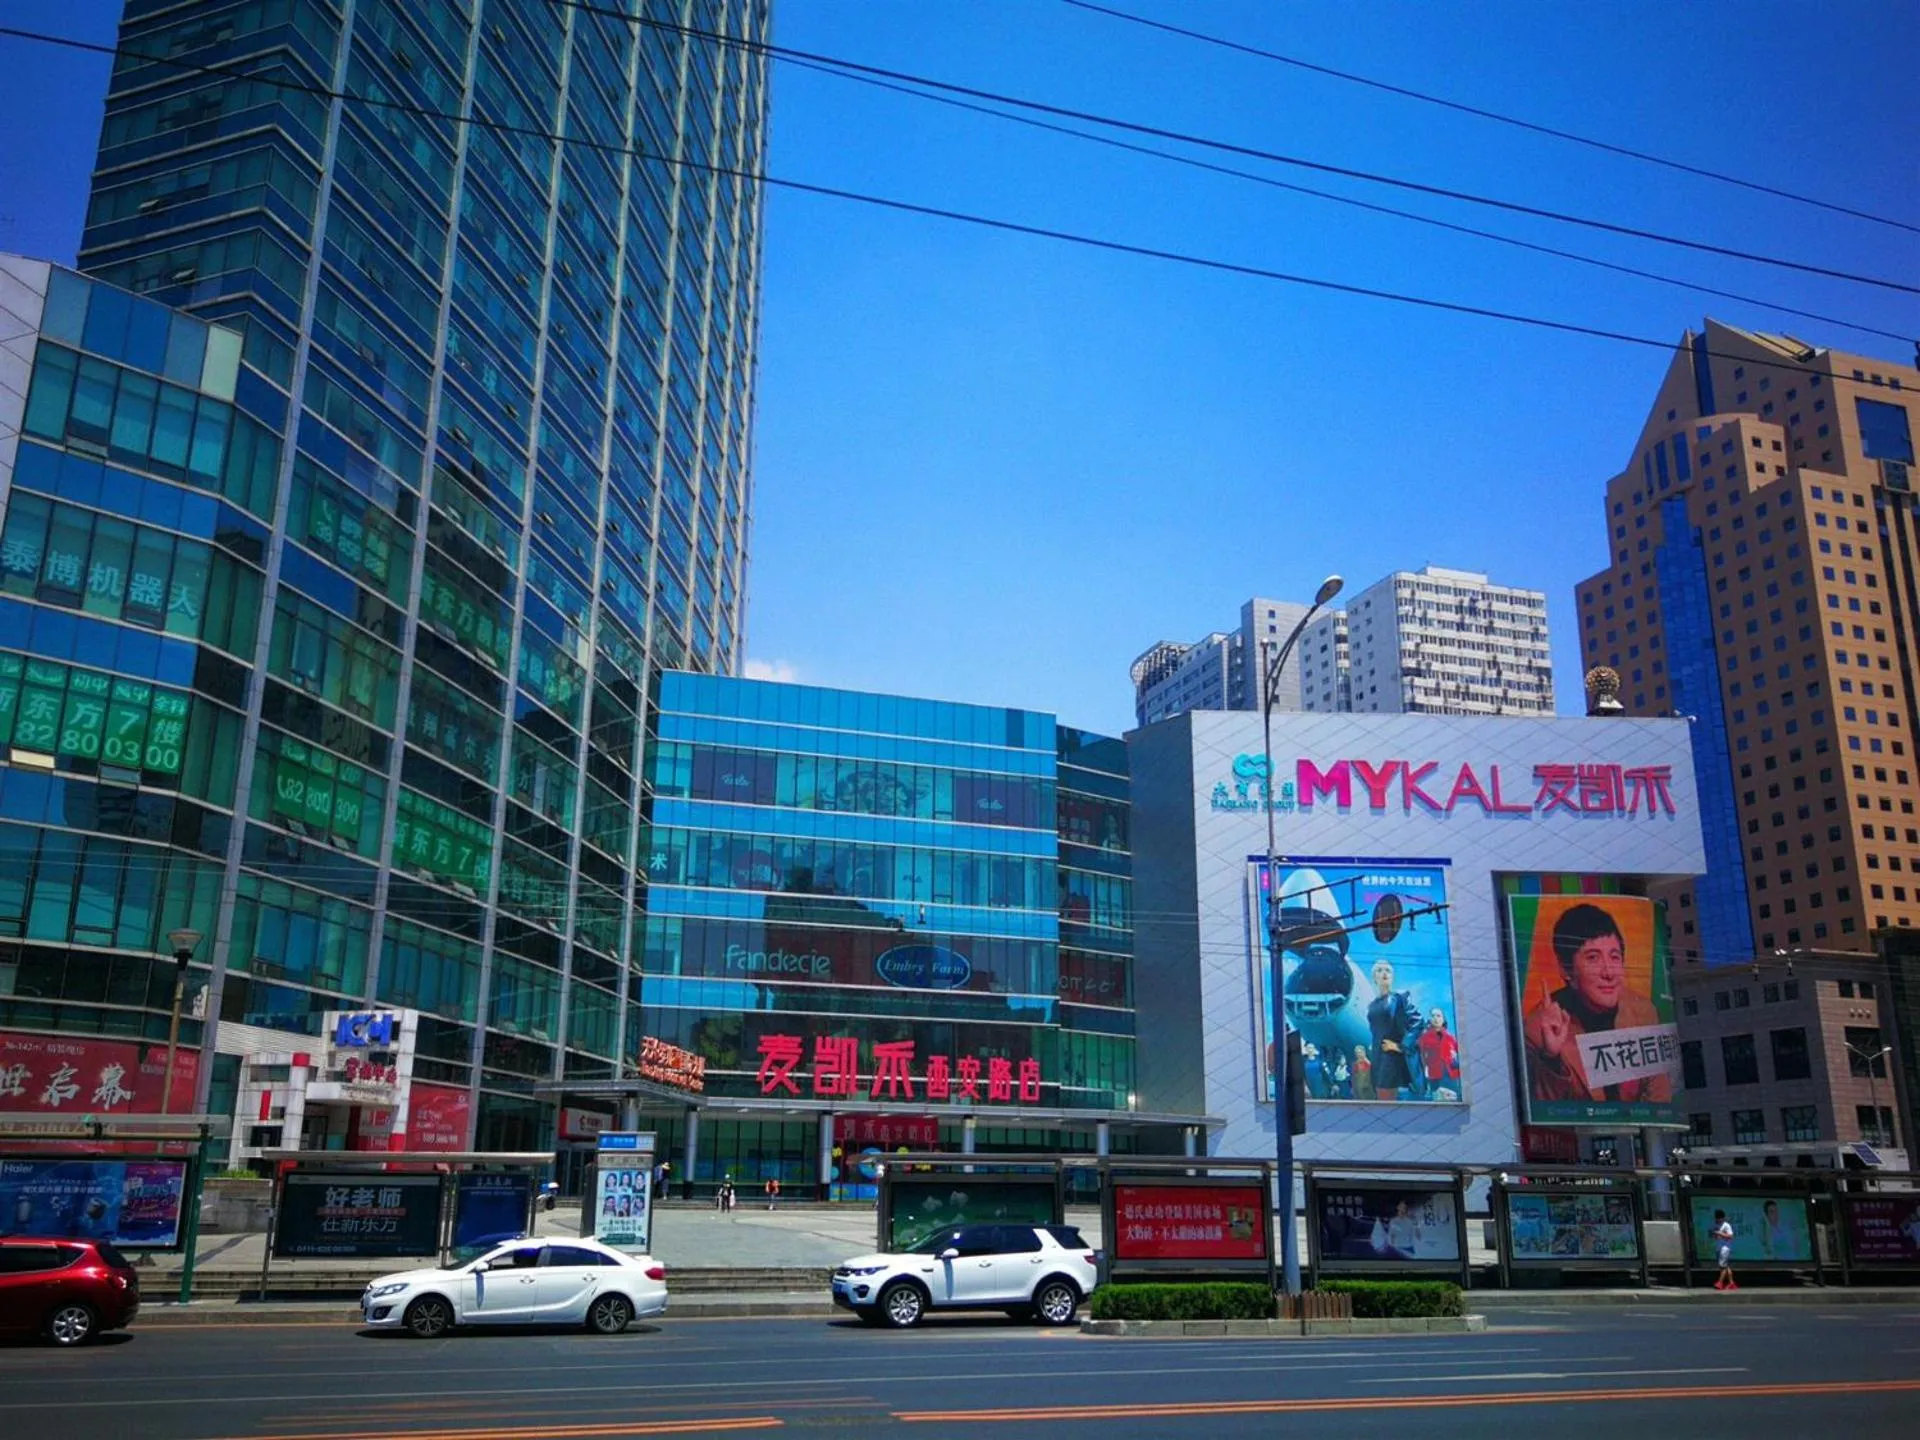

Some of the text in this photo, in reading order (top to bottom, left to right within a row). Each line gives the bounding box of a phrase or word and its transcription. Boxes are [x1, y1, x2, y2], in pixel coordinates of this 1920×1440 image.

[1296, 758, 1533, 813] MYKAL
[726, 944, 832, 975] Fandecie
[884, 959, 925, 976] Embry
[4, 1163, 33, 1174] Haier
[325, 1186, 403, 1208] 好老师
